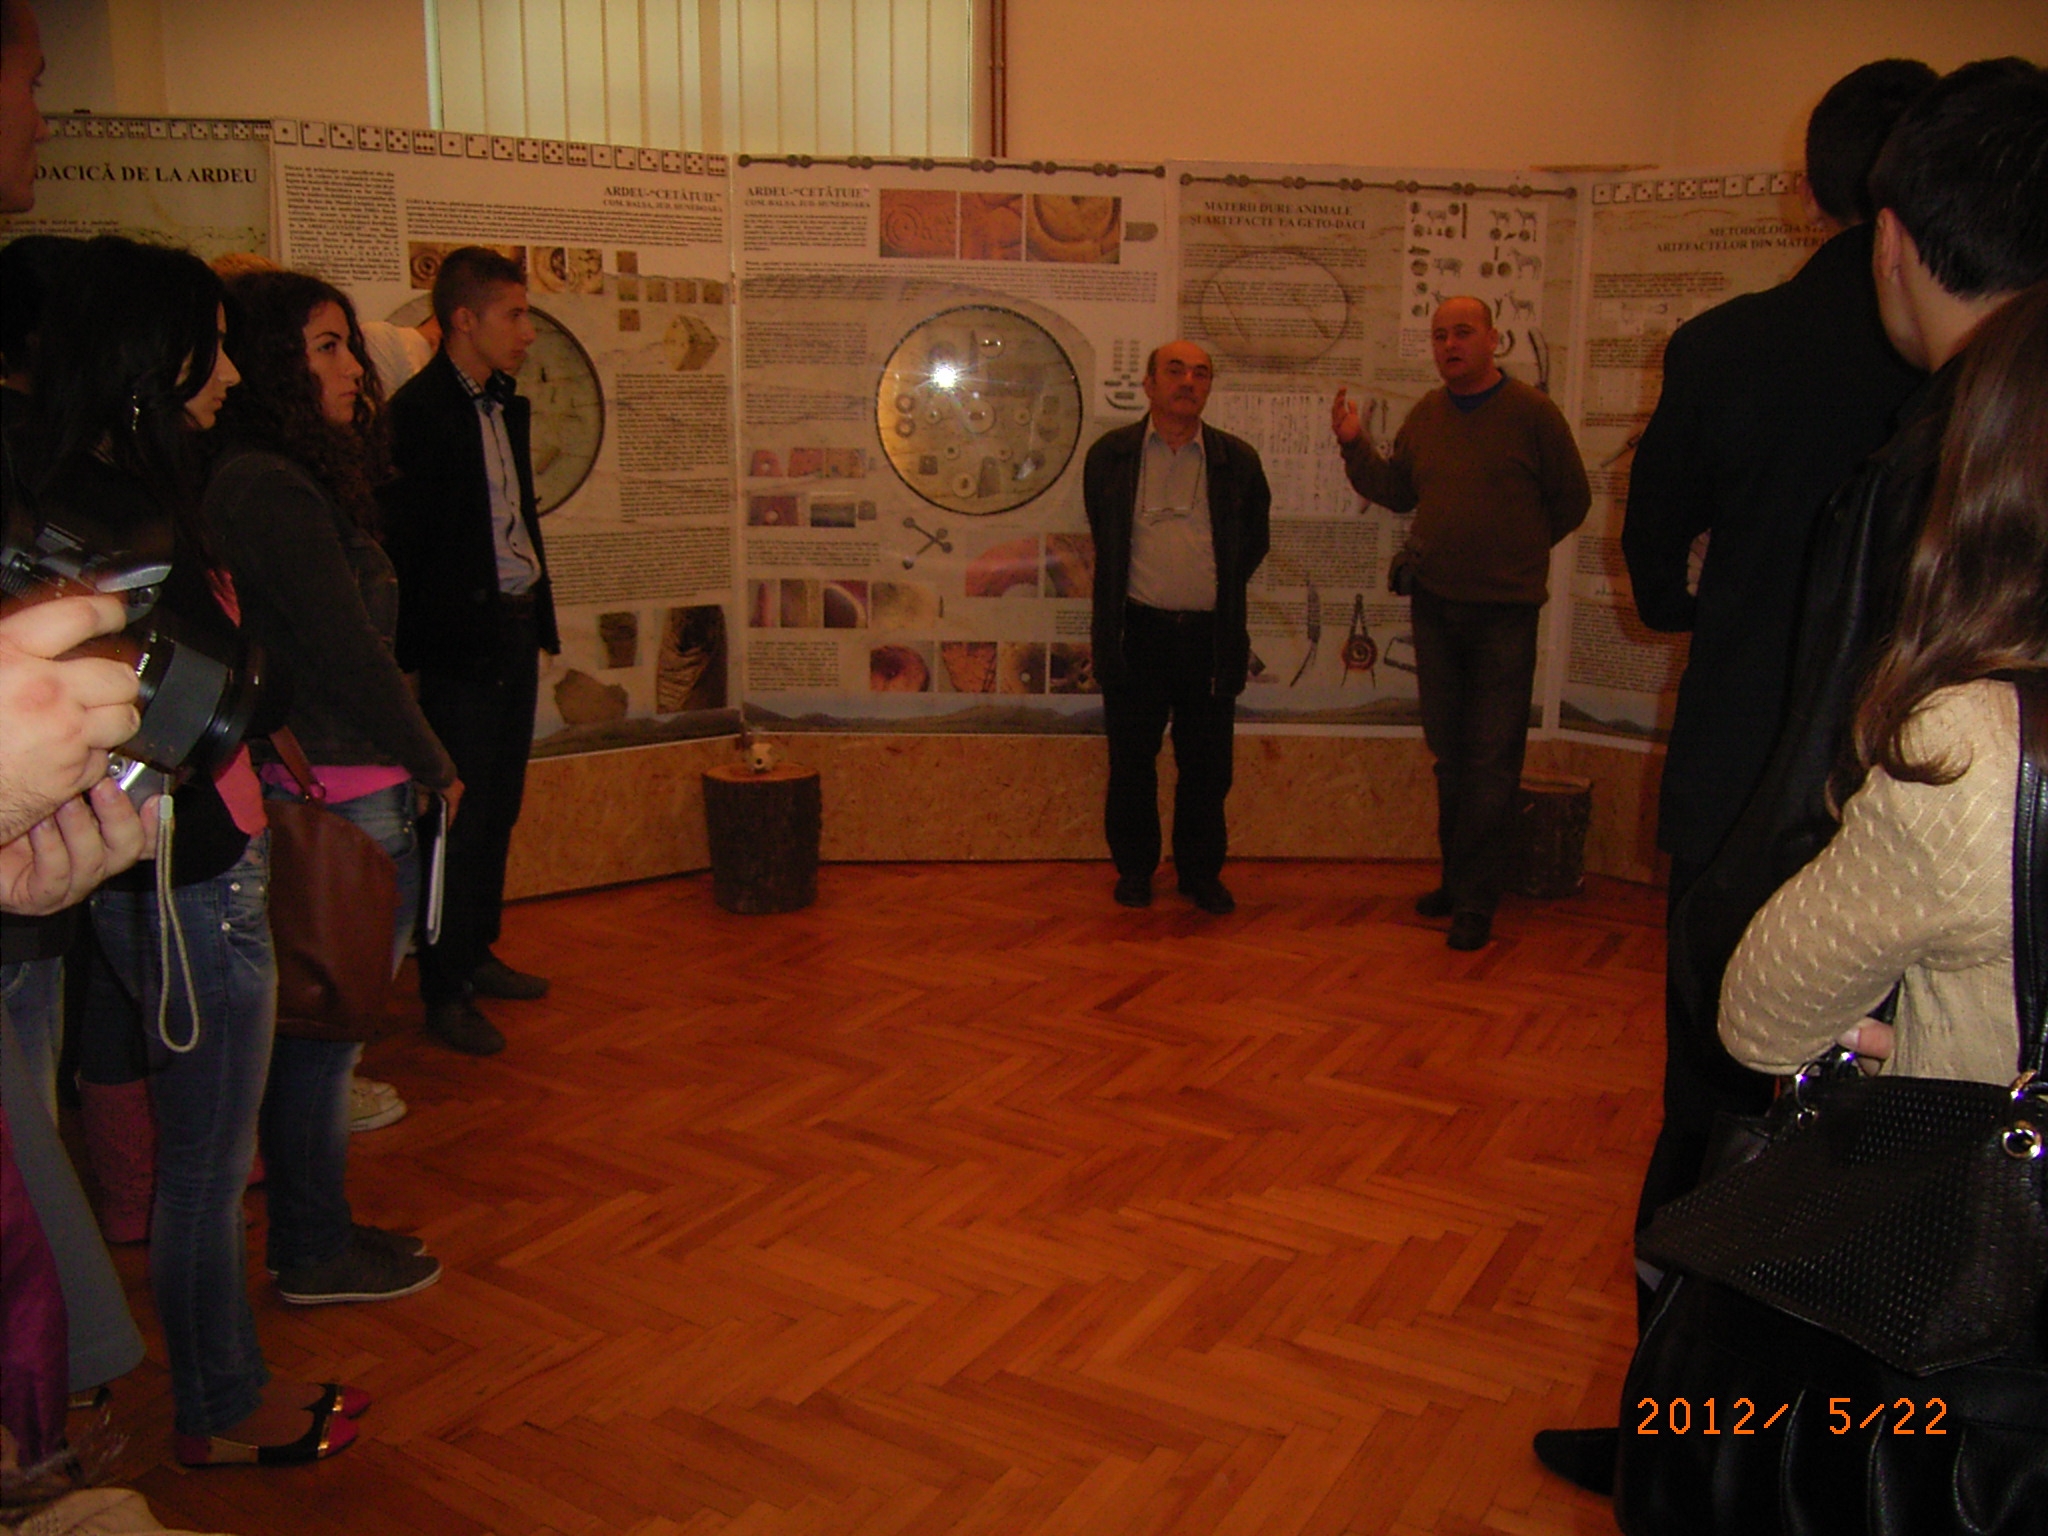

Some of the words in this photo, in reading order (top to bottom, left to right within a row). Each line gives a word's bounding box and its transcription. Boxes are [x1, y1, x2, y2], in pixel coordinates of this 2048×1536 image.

[121, 165, 149, 182] DE
[156, 166, 182, 182] LA
[187, 167, 257, 184] ARDEU
